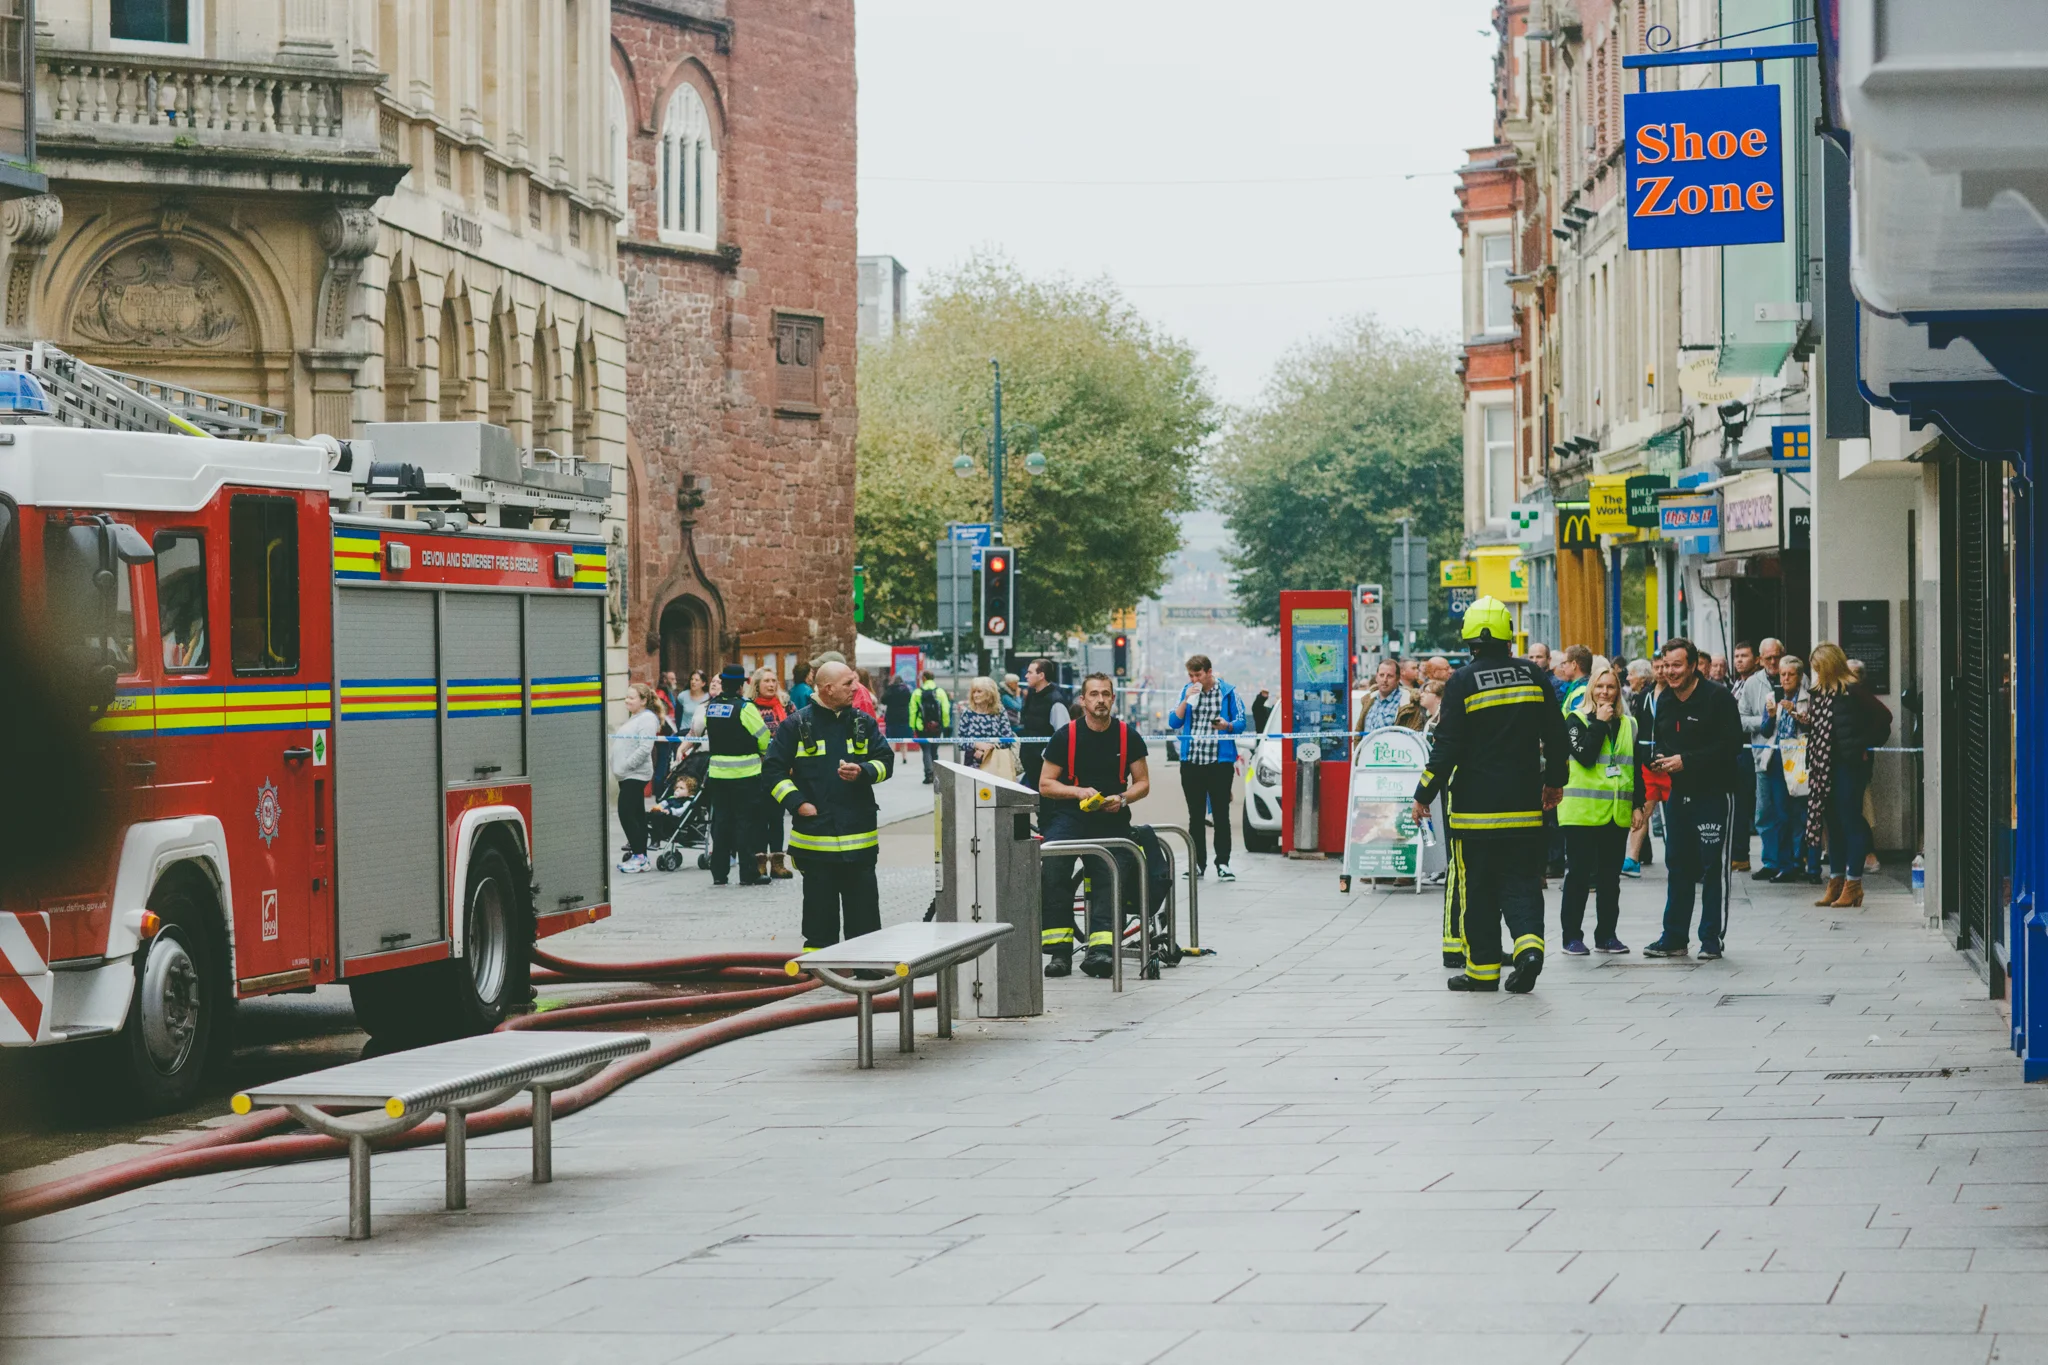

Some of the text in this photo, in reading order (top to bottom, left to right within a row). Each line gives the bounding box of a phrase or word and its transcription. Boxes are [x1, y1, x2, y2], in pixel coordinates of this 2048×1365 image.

[1636, 122, 1768, 165] Shoe
[1633, 176, 1774, 217] Zone
[137, 307, 184, 323] BANK
[1603, 495, 1623, 505] The
[1631, 487, 1655, 499] HOLLA
[1631, 505, 1660, 516] BARRET
[1665, 510, 1687, 526] this
[1690, 509, 1699, 523] is
[1702, 508, 1713, 523] it
[421, 550, 444, 567] DEVON
[446, 552, 460, 568] AND
[462, 553, 495, 570] SOMERSET
[495, 556, 508, 571] FIRE
[515, 557, 539, 573] RESCUE
[1477, 666, 1533, 689] FIRE
[1373, 742, 1412, 763] Ferns
[1697, 823, 1722, 832] BRONX
[264, 920, 276, 936] 999
